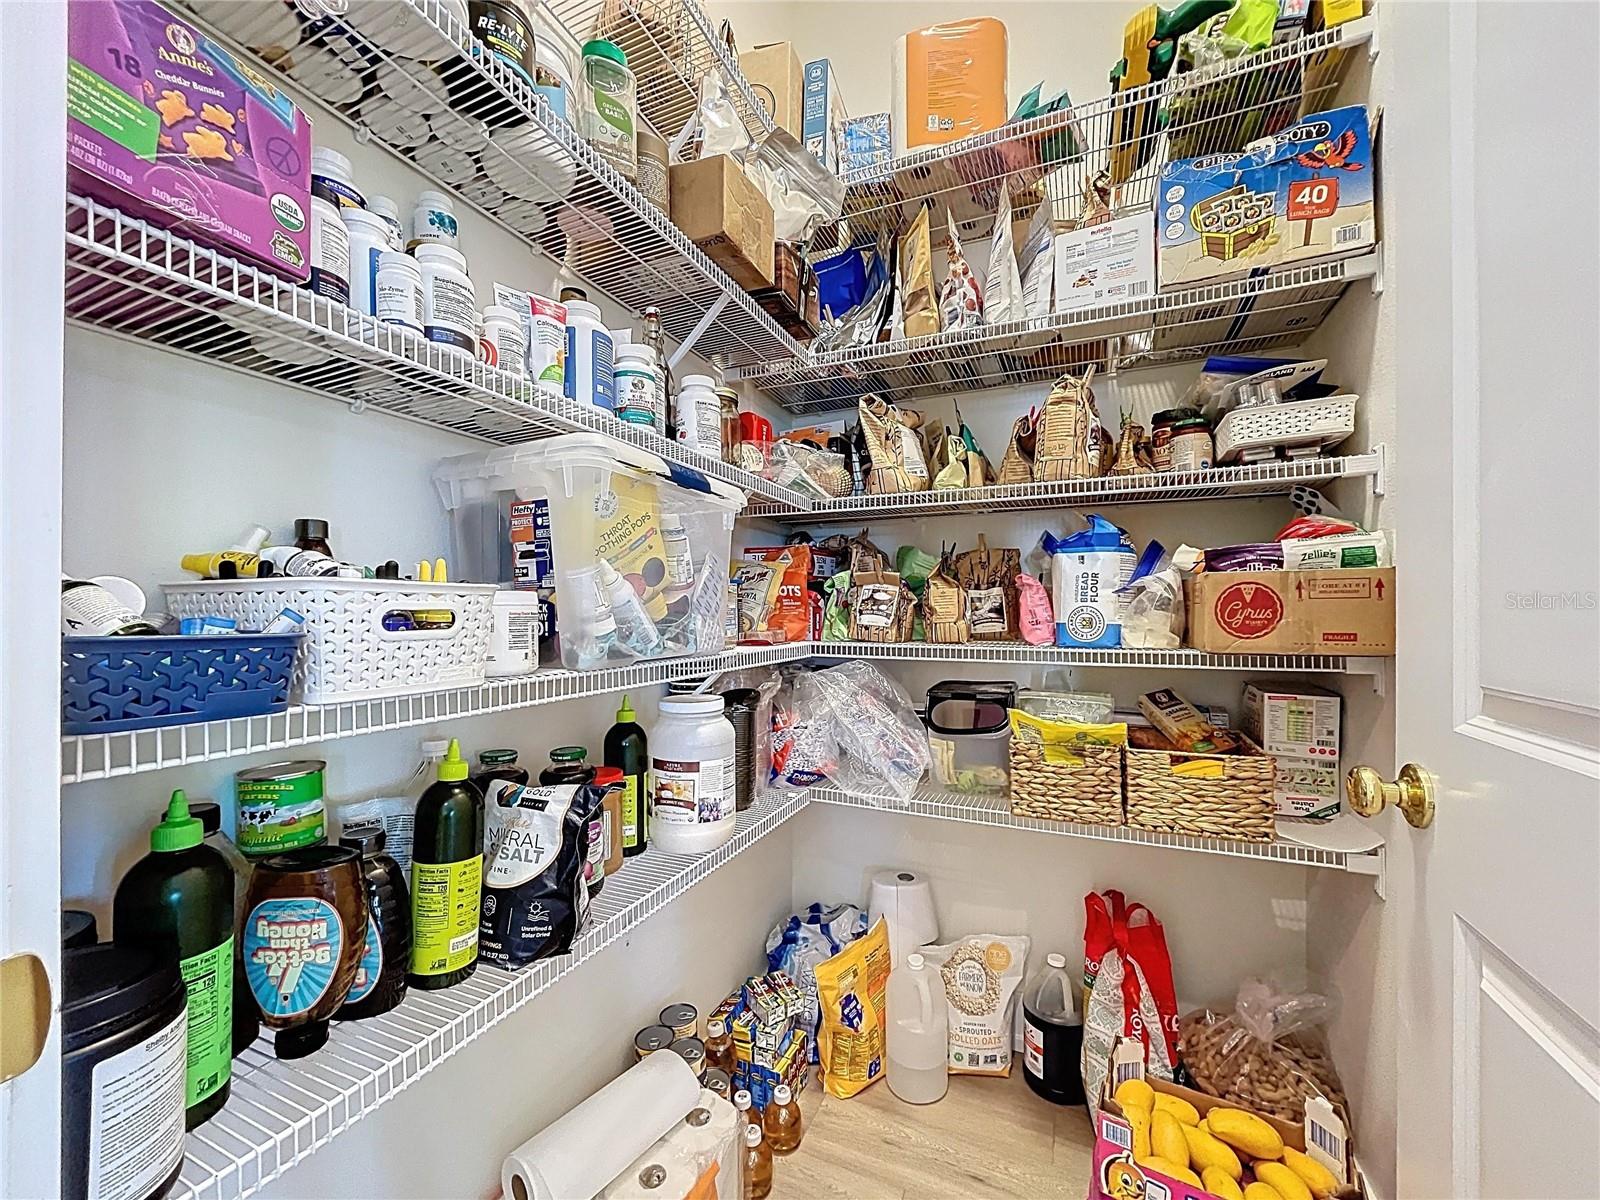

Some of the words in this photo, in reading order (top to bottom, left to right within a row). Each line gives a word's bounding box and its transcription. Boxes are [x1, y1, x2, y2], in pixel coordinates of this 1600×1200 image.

[477, 15, 529, 52] RE-LYTE
[108, 47, 142, 79] 18
[159, 46, 213, 77] Annie's
[155, 69, 191, 88] Cheddar
[192, 81, 225, 98] Bunnies
[604, 108, 625, 121] BASIL
[1202, 152, 1245, 168] PIRAT
[1273, 125, 1320, 145] OOTY
[1295, 184, 1329, 205] 40
[278, 198, 299, 217] USDA
[1289, 209, 1312, 218] LUNCH
[1313, 207, 1331, 216] BAGS
[513, 505, 535, 515] Hefty
[511, 518, 534, 527] PROTECT
[600, 514, 632, 542] THROAT
[594, 527, 632, 557] OTHING
[630, 512, 652, 532] POPS
[1301, 549, 1337, 562] Zellie's
[779, 585, 801, 597] OTS
[1080, 571, 1090, 603] BREAD
[1090, 572, 1100, 603] FLOUR
[742, 591, 757, 601] ENTA
[1070, 608, 1085, 626] ARTHUR
[1224, 601, 1273, 628] Cyrus
[1071, 626, 1085, 638] KING
[239, 783, 295, 792] alifornia
[525, 787, 552, 798] GOLD
[1291, 800, 1315, 808] Dates
[499, 846, 545, 865] SALT
[256, 917, 328, 940] Honey
[270, 937, 311, 950] than
[200, 953, 217, 965] Facts
[252, 945, 331, 969] Better
[202, 975, 216, 988] 120
[958, 972, 984, 983] FARMERS
[965, 982, 983, 994] KNOW
[949, 1031, 980, 1046] ROLLED
[981, 1036, 1003, 1046] OATS
[959, 1027, 992, 1036] SPROUTED
